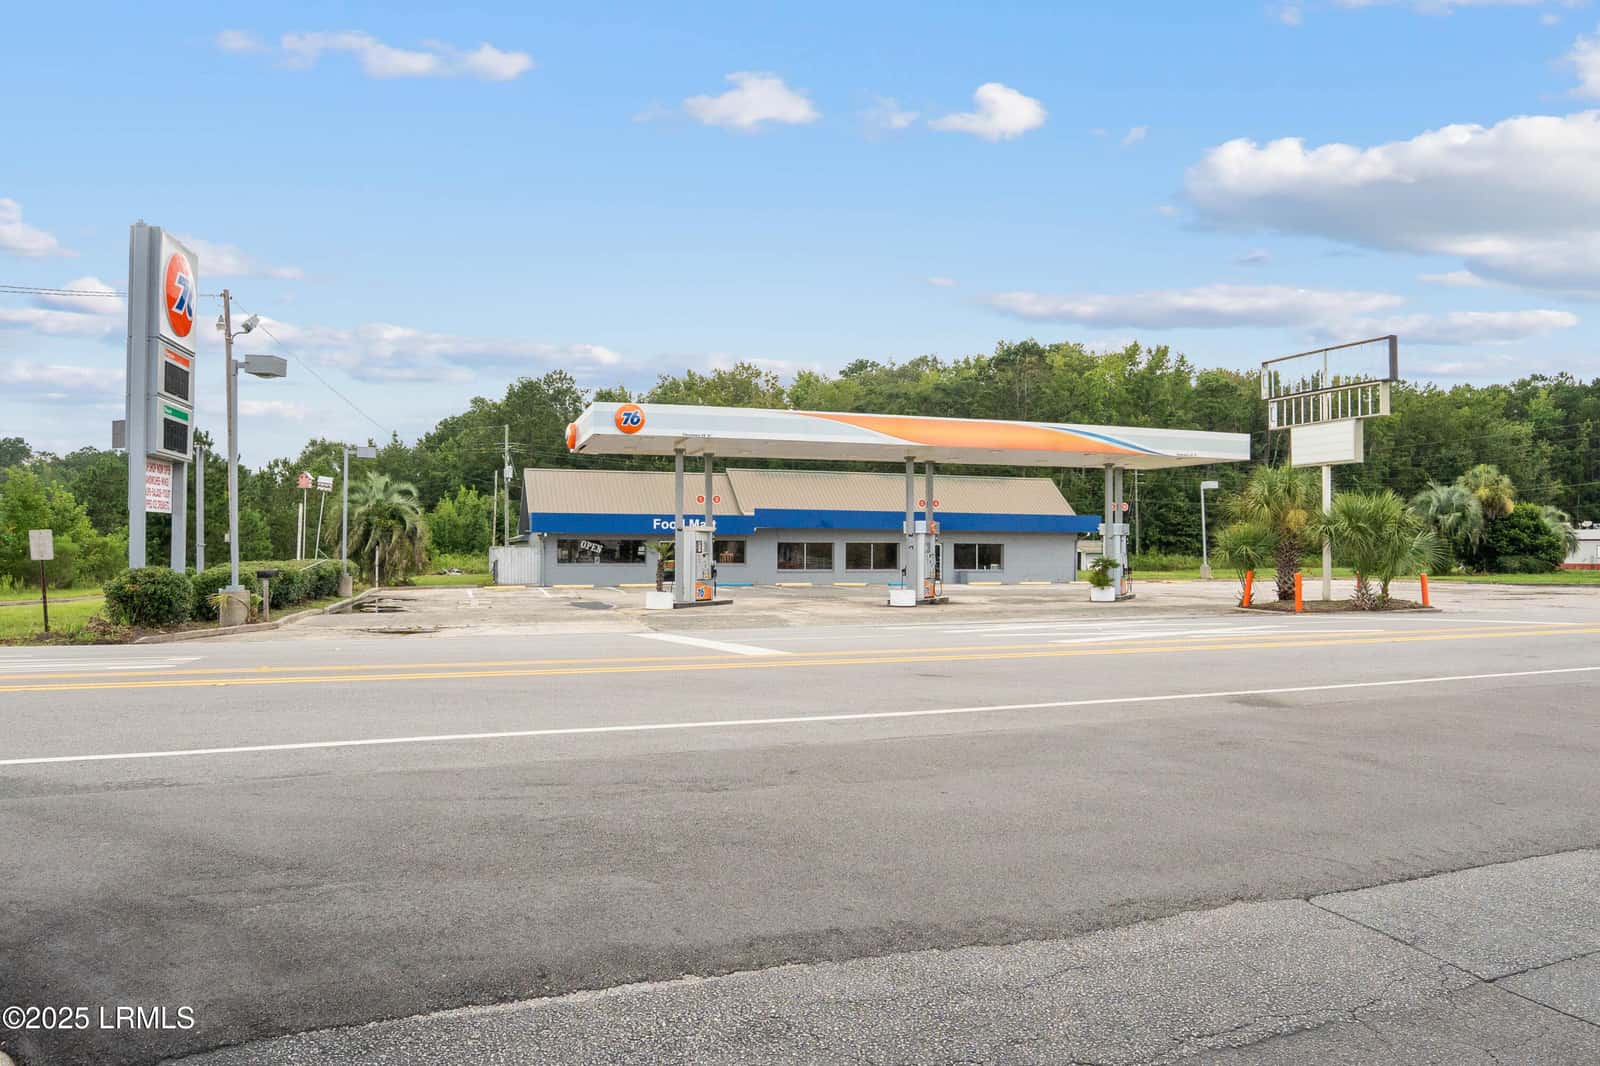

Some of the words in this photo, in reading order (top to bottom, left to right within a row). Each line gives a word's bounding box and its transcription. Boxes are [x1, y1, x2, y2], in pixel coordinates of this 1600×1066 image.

[621, 411, 641, 426] 76
[689, 518, 717, 530] Mat
[580, 540, 603, 554] OPEN
